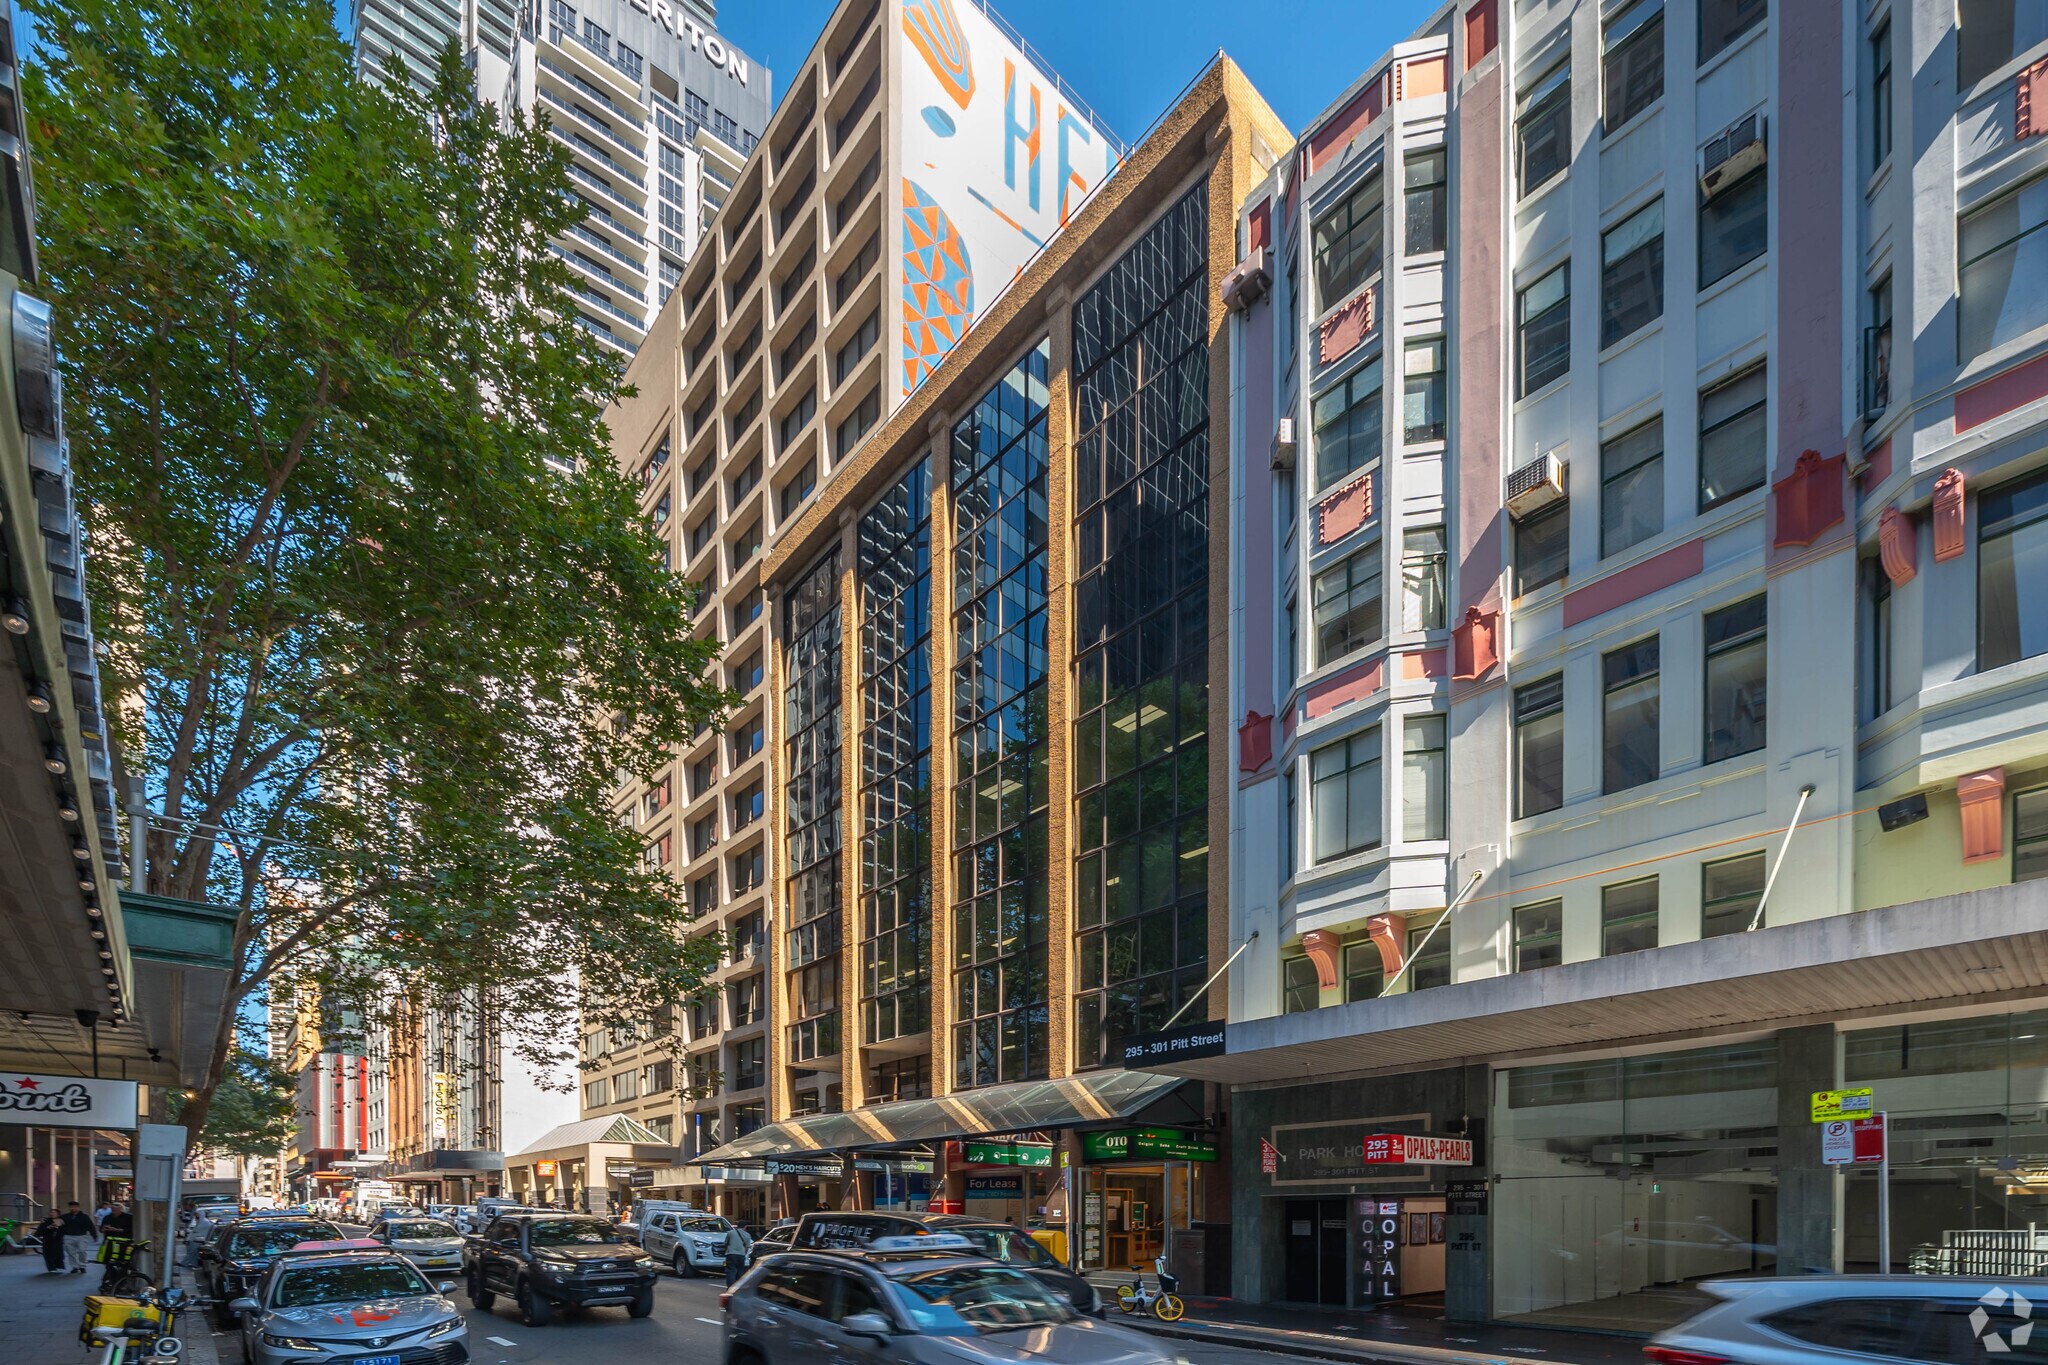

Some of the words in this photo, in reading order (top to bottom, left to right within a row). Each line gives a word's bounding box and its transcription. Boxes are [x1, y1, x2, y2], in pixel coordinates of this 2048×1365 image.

[1125, 1046, 1143, 1058] 295
[1150, 1041, 1168, 1054] 301
[1171, 1038, 1189, 1050] Pitt
[1191, 1032, 1224, 1047] Street
[1105, 1136, 1128, 1148] OTO
[1366, 1139, 1389, 1150] 295
[1298, 1146, 1336, 1160] PARK
[1343, 1145, 1365, 1157] HO
[1367, 1150, 1389, 1160] PITT
[779, 1163, 795, 1173] $20
[969, 1178, 987, 1189] For
[989, 1178, 1017, 1189] Lease
[1447, 1191, 1462, 1199] PITT
[1464, 1191, 1486, 1199] STREET
[825, 1223, 873, 1239] PROFILE
[1381, 1219, 1397, 1296] OPAL
